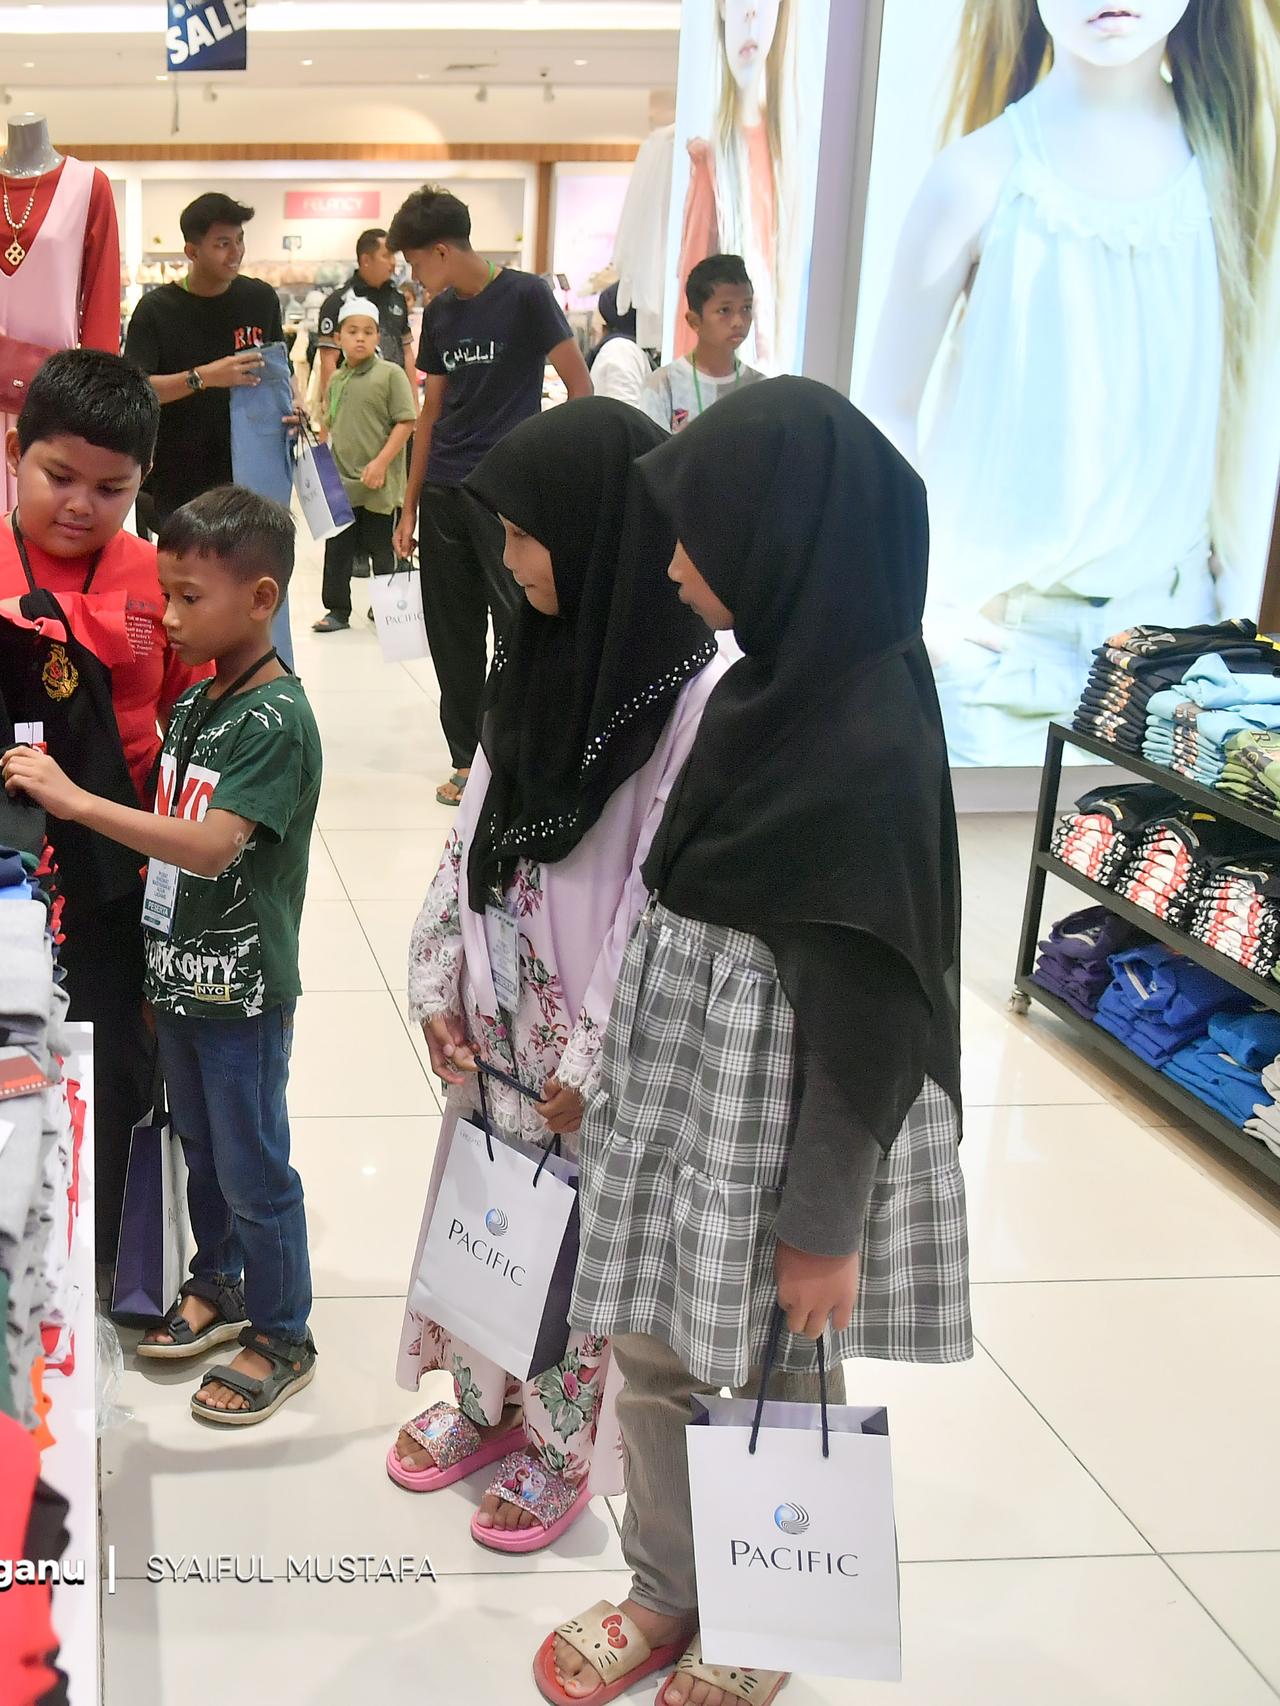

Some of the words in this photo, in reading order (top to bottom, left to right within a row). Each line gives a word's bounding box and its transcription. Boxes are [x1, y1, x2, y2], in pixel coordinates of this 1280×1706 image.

[166, 0, 246, 64] SALE
[197, 985, 225, 996] NYC
[448, 1217, 527, 1288] PACIFIC
[730, 1538, 860, 1578] PACIFIC
